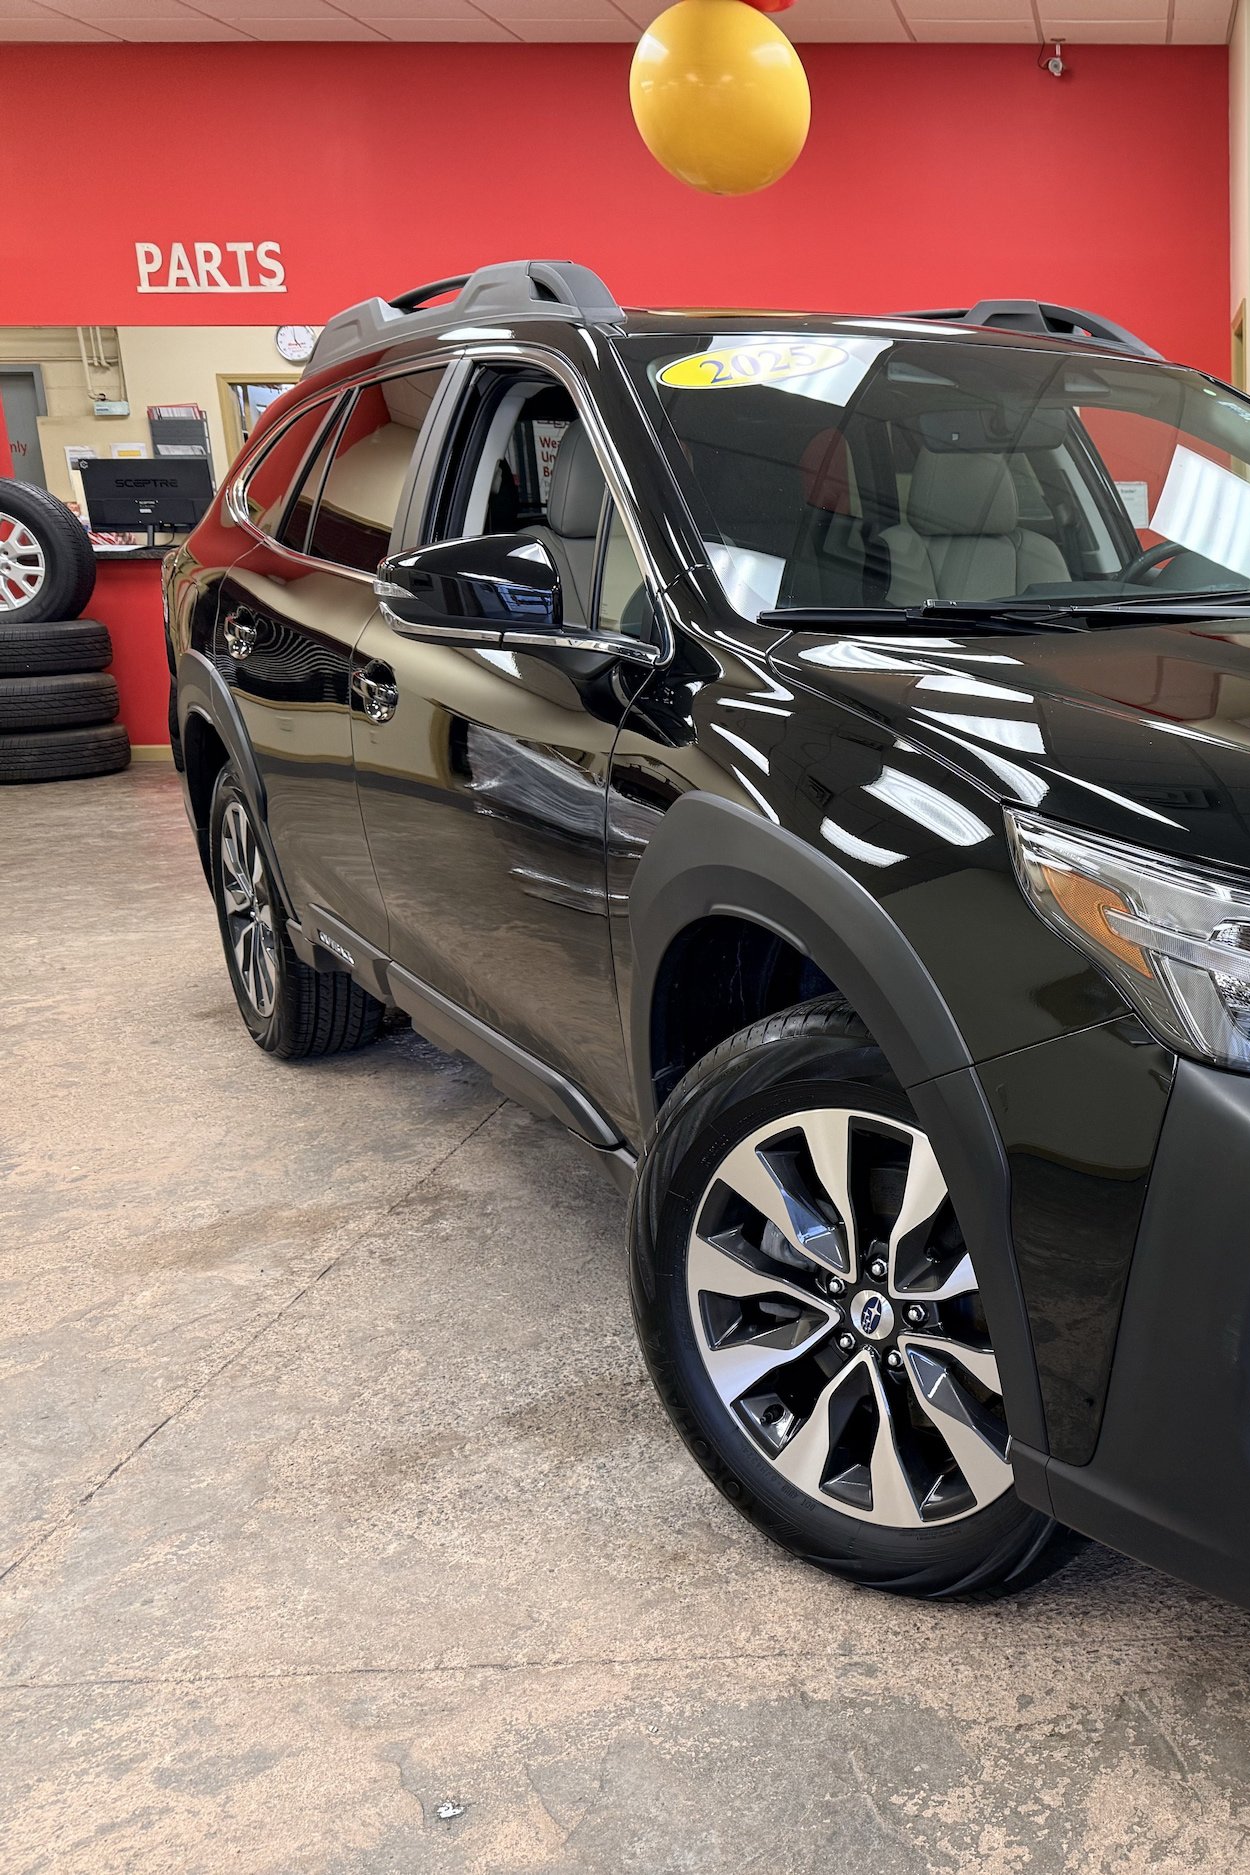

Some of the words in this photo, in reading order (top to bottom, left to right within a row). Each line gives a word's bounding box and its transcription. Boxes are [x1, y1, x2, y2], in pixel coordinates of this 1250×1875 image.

[134, 240, 286, 293] PARTS
[699, 345, 817, 384] 2025
[9, 440, 27, 457] nly
[115, 479, 179, 488] SCEPTRE
